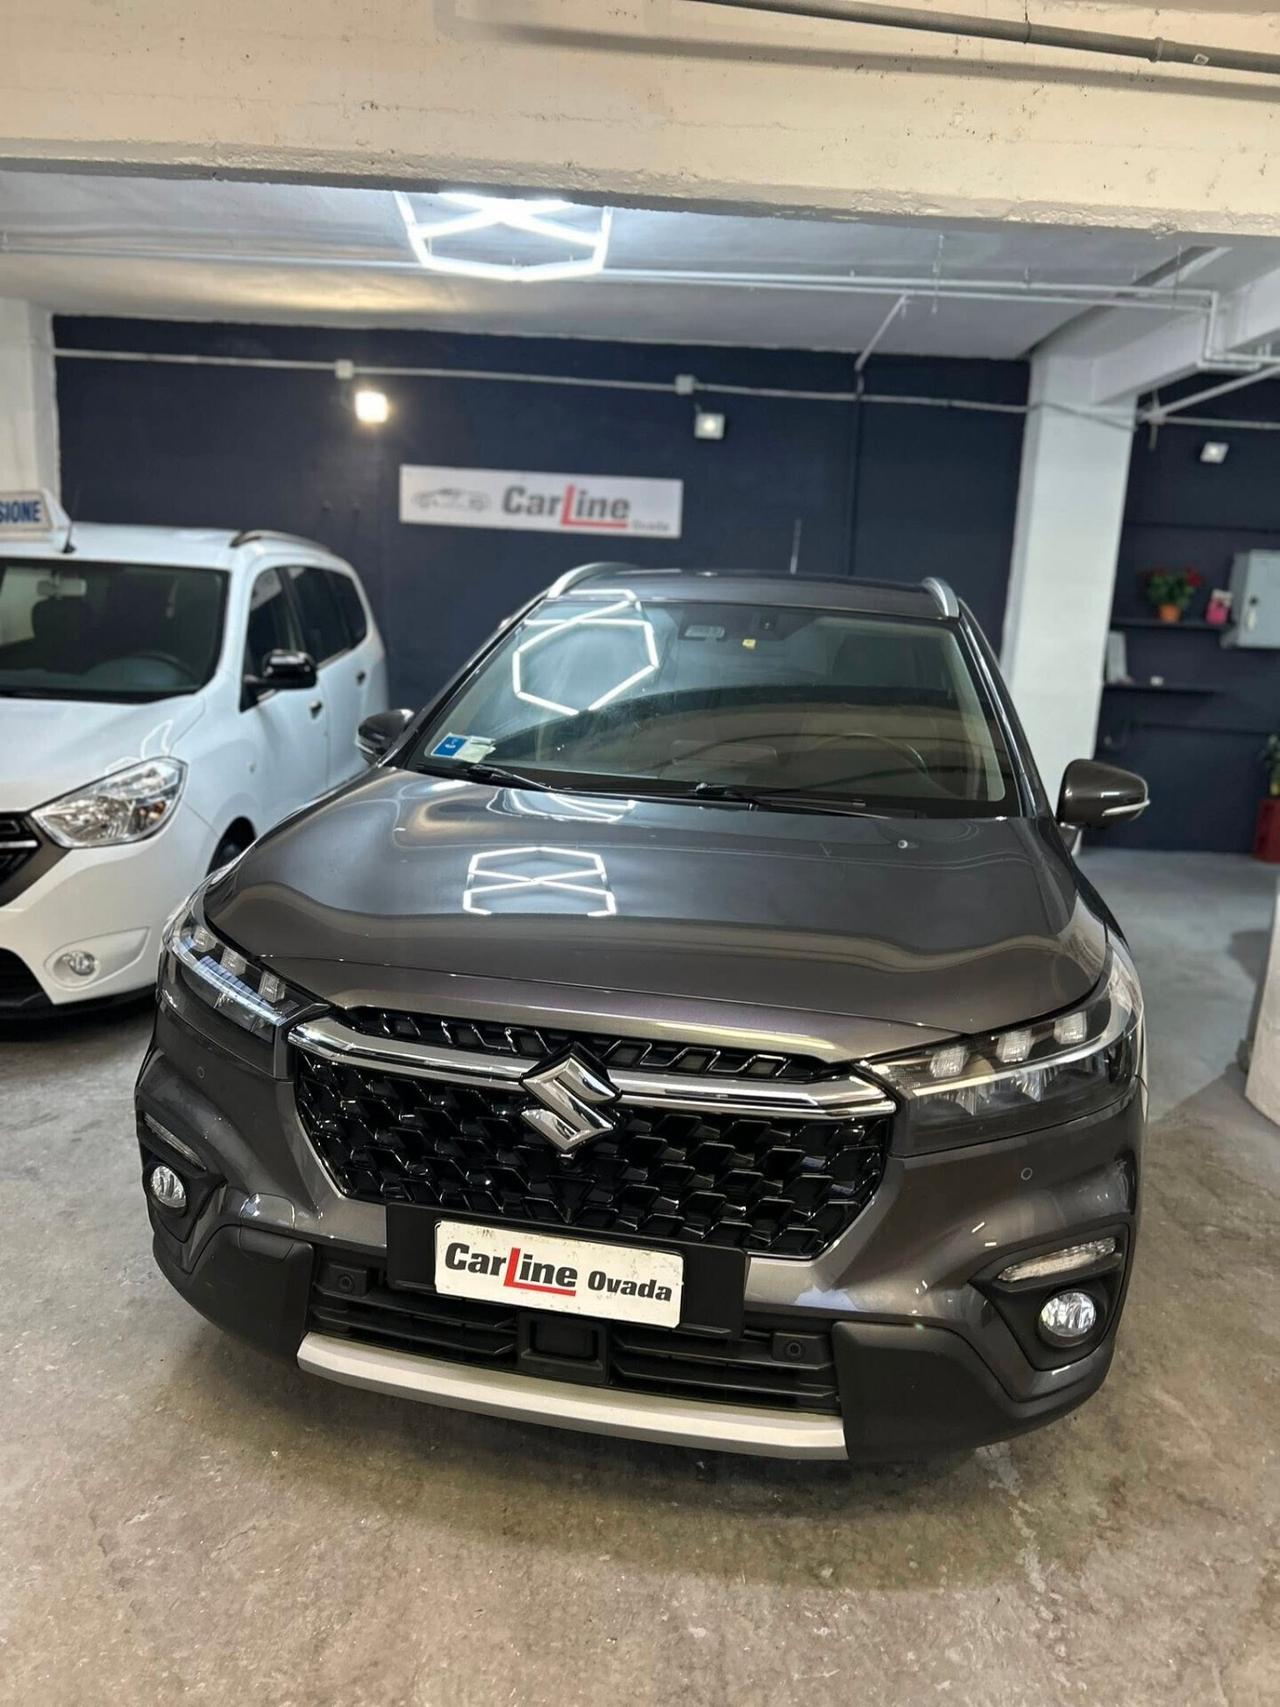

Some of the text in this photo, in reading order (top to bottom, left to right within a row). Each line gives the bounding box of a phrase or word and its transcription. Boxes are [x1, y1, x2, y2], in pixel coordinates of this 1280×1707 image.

[502, 484, 630, 529] CarLine
[445, 1242, 672, 1302] CarLine Ovada
